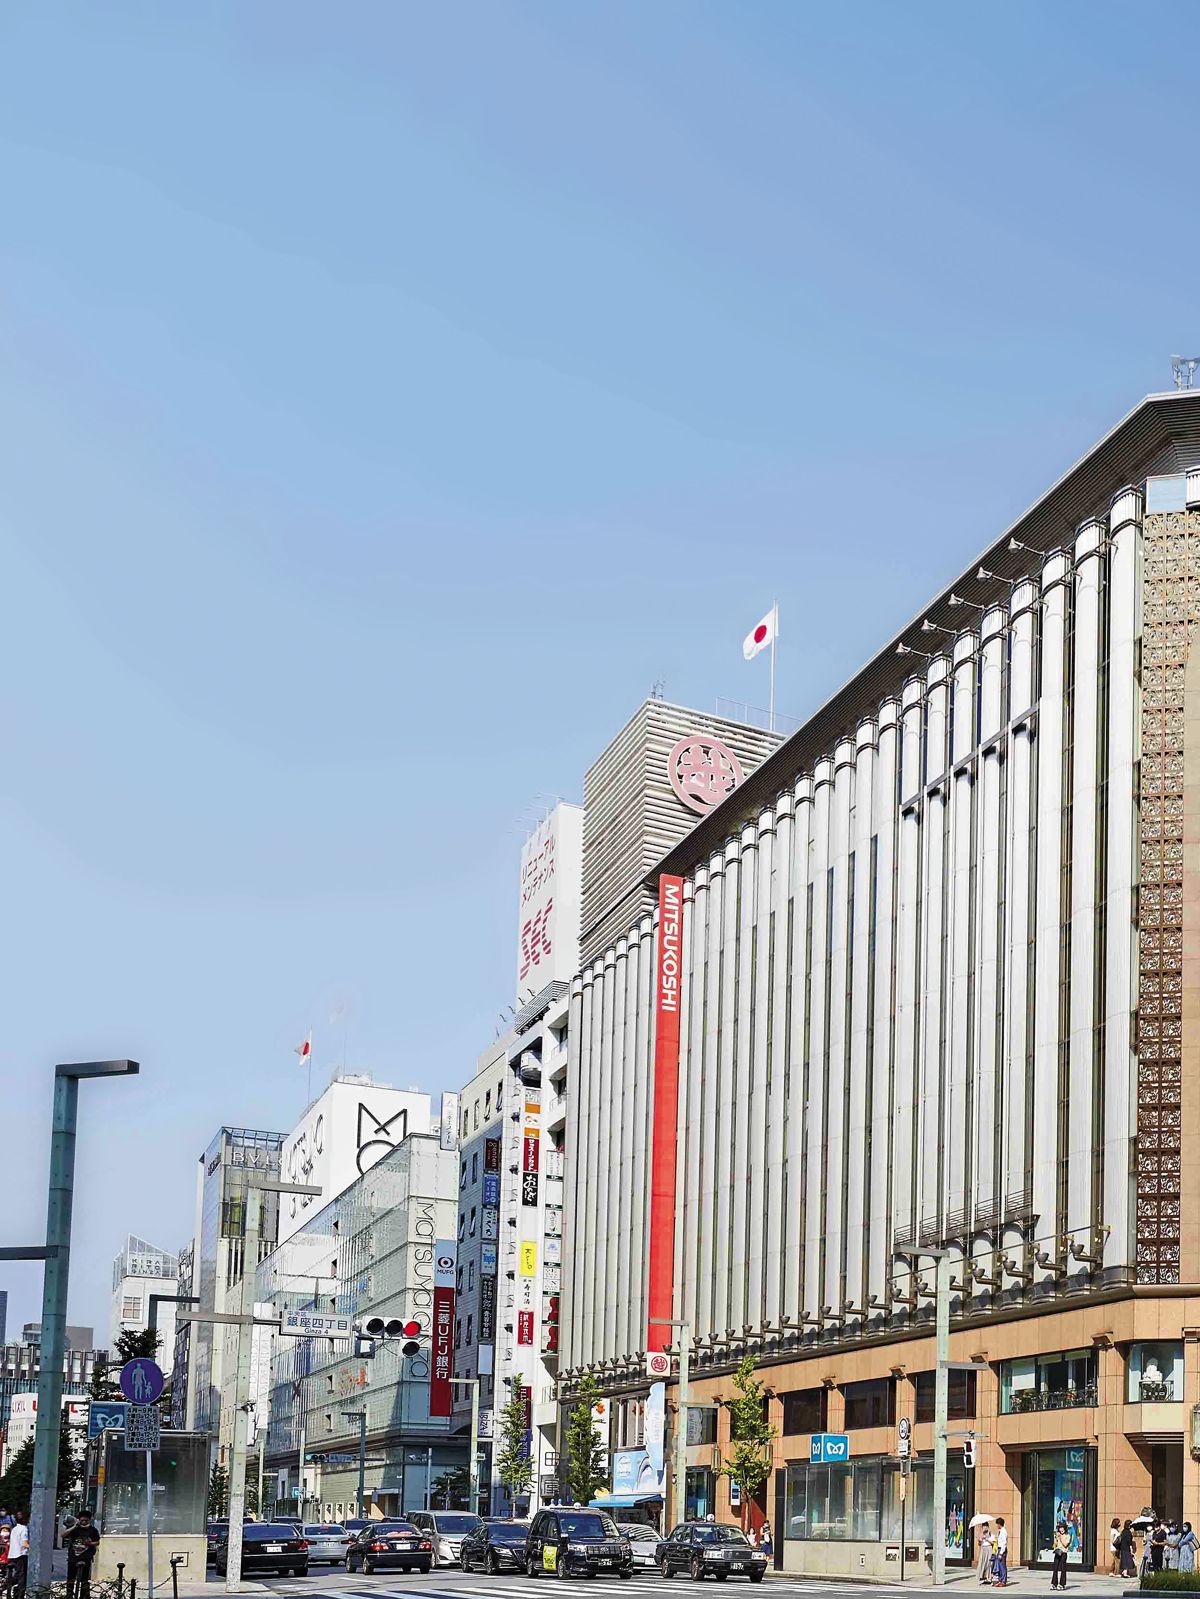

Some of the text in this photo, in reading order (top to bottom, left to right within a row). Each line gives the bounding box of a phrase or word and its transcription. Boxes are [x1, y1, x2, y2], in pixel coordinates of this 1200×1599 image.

[662, 884, 680, 1012] MITSUKOSHI
[287, 1316, 348, 1330] 銀座四丁目
[436, 1301, 450, 1379] 三菱UFJ銀行
